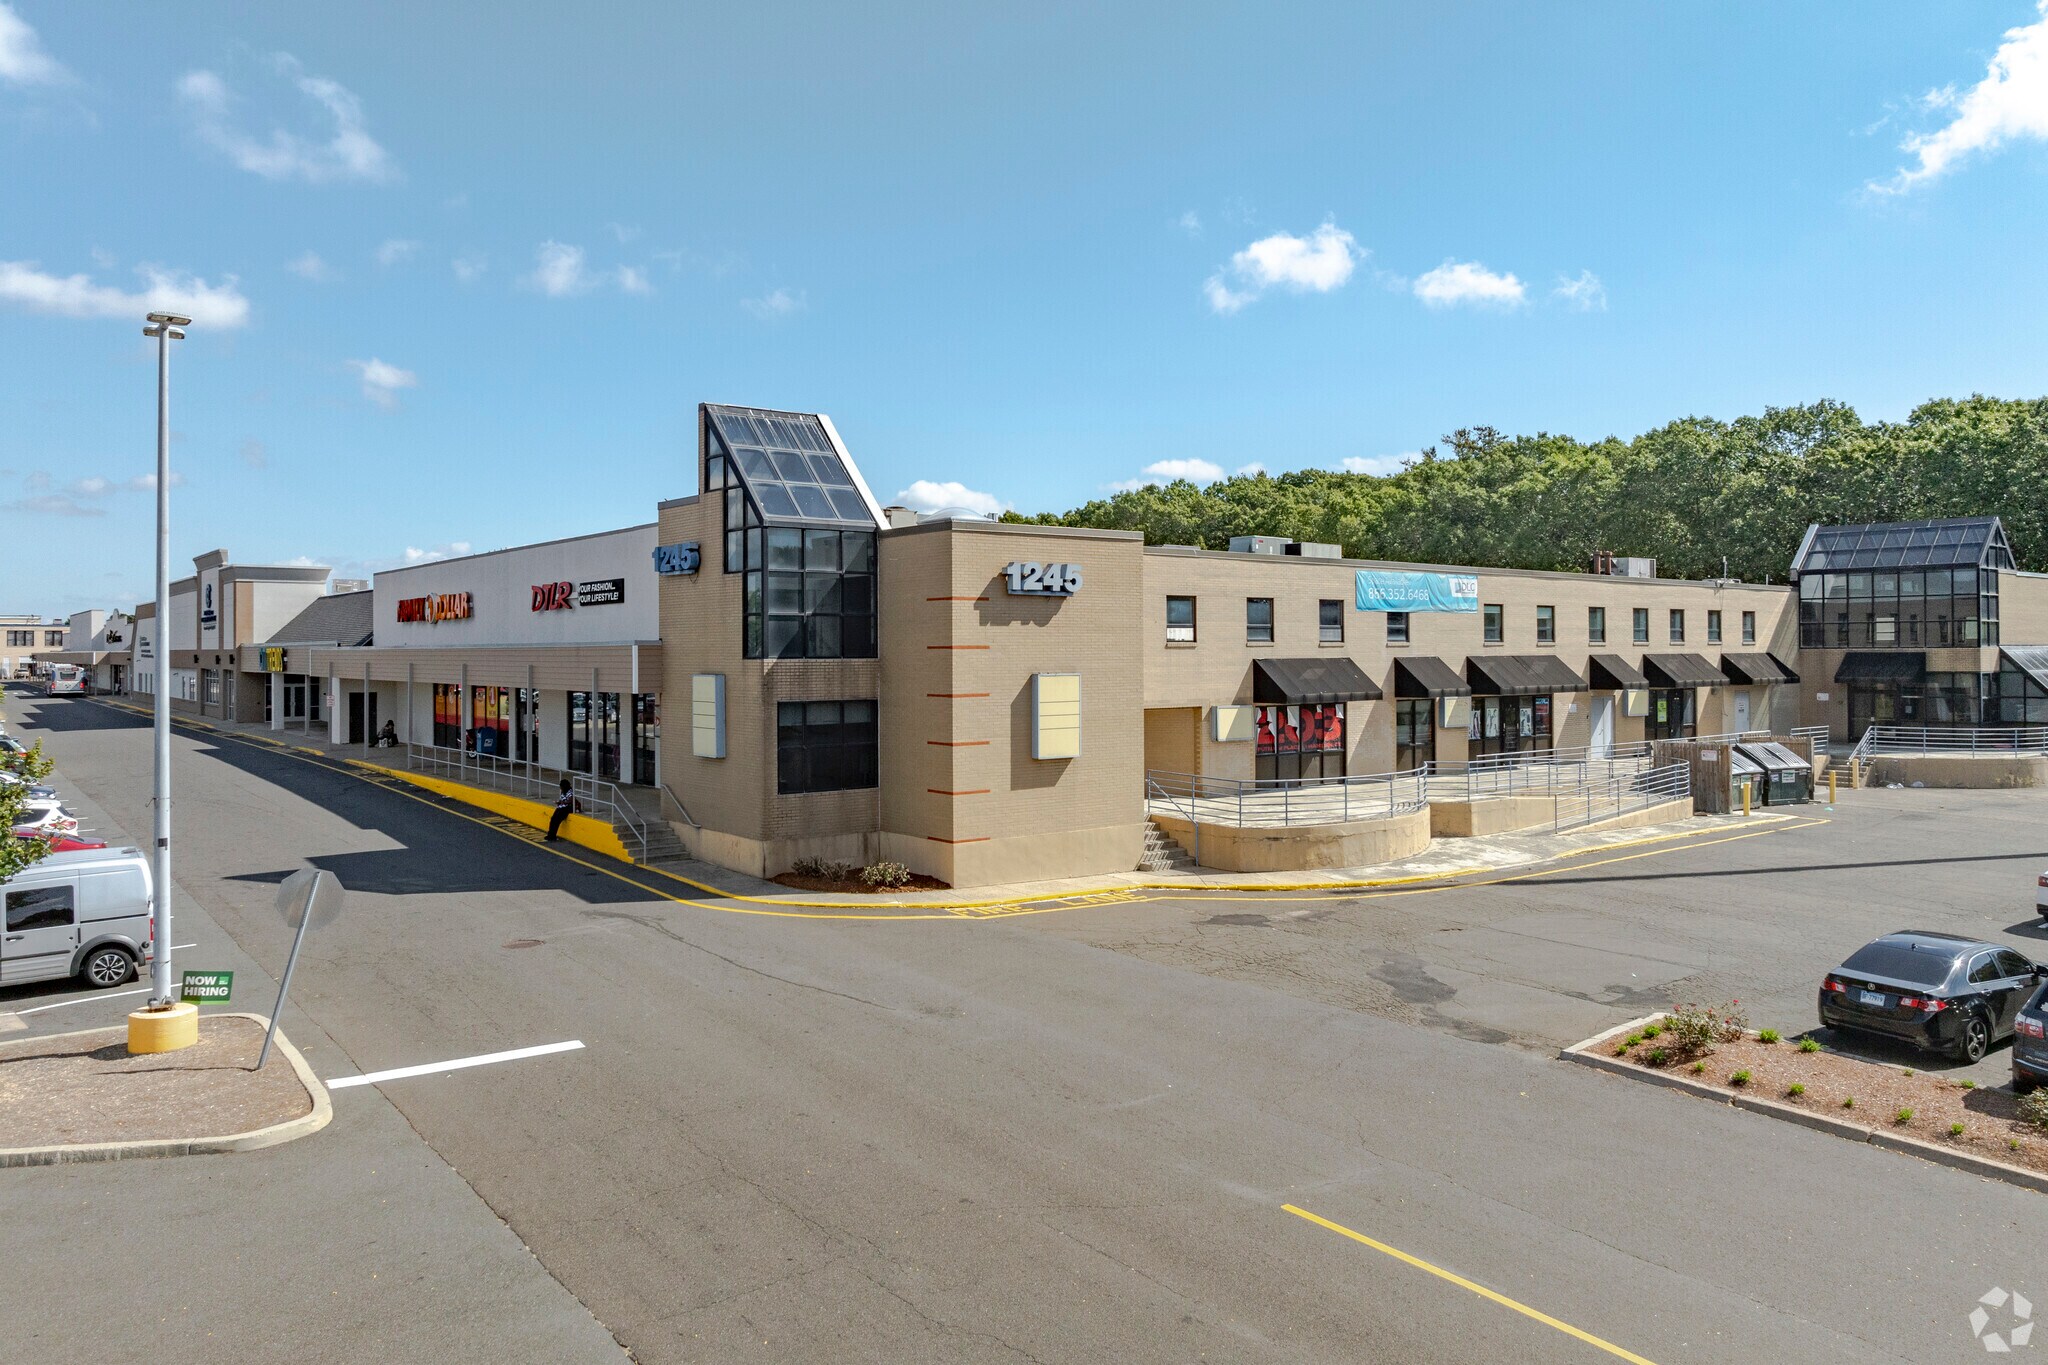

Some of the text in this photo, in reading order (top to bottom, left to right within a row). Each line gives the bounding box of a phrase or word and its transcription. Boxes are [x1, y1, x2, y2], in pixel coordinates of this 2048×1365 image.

[651, 542, 699, 571] 1245
[1002, 562, 1083, 592] 1245
[531, 581, 572, 612] DTLR
[1462, 583, 1475, 591] DLC
[185, 976, 217, 985] NOW
[184, 987, 229, 996] HIRING
